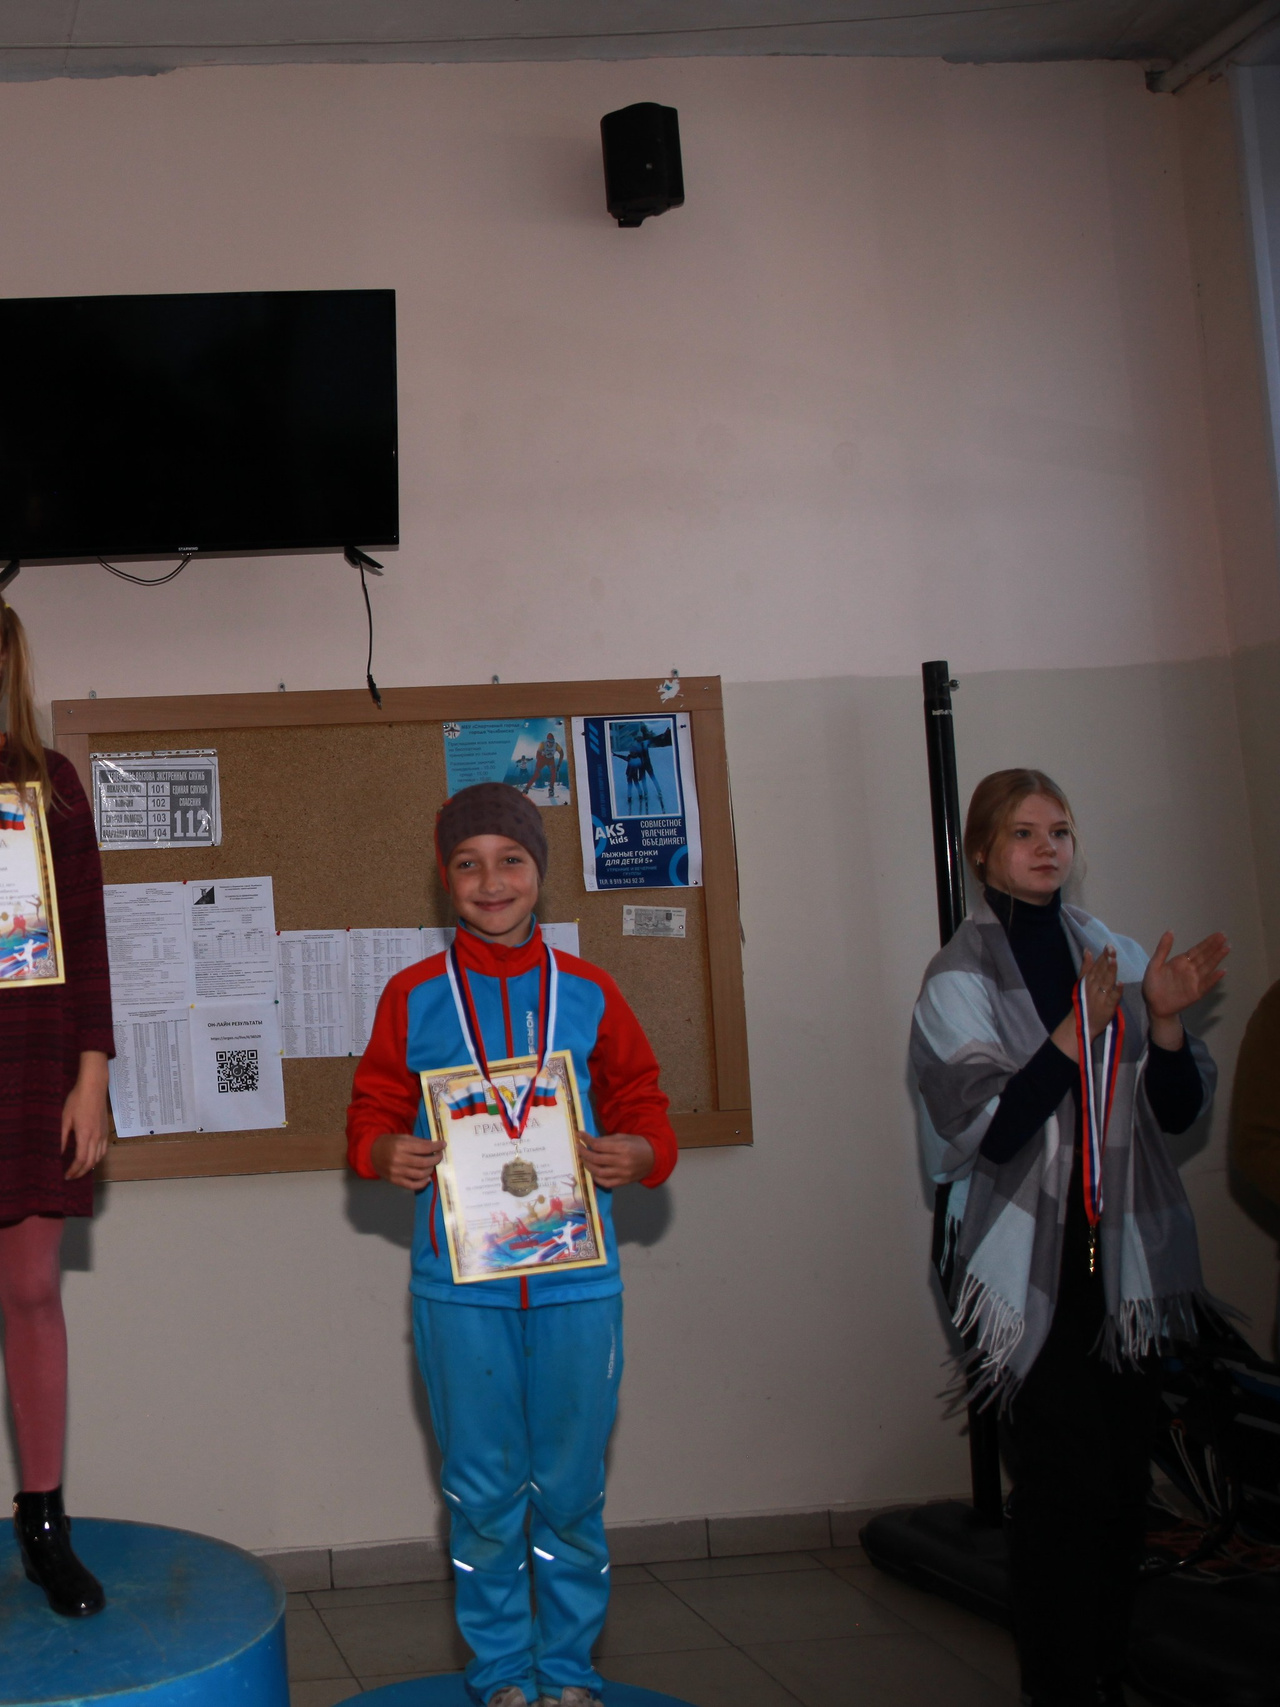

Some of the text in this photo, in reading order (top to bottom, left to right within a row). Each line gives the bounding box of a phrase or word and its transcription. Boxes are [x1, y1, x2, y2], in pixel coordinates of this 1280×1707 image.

[151, 785, 164, 793] 101
[152, 798, 165, 807] 102
[152, 813, 166, 822] 103
[173, 809, 209, 837] 112
[640, 818, 682, 829] СОВМЕСТНОЕ
[153, 828, 167, 837] 104
[595, 822, 625, 840] AKS
[640, 828, 677, 838] УВЛЕЧЕНИЕ
[609, 836, 628, 845] kids
[641, 836, 686, 846] ОБЪЕДИНЯЕТ!
[601, 850, 633, 858] ЛЫЖНЫЕ
[621, 857, 644, 866] ДЕТЕЙ
[474, 1117, 540, 1135] ГРАТА
